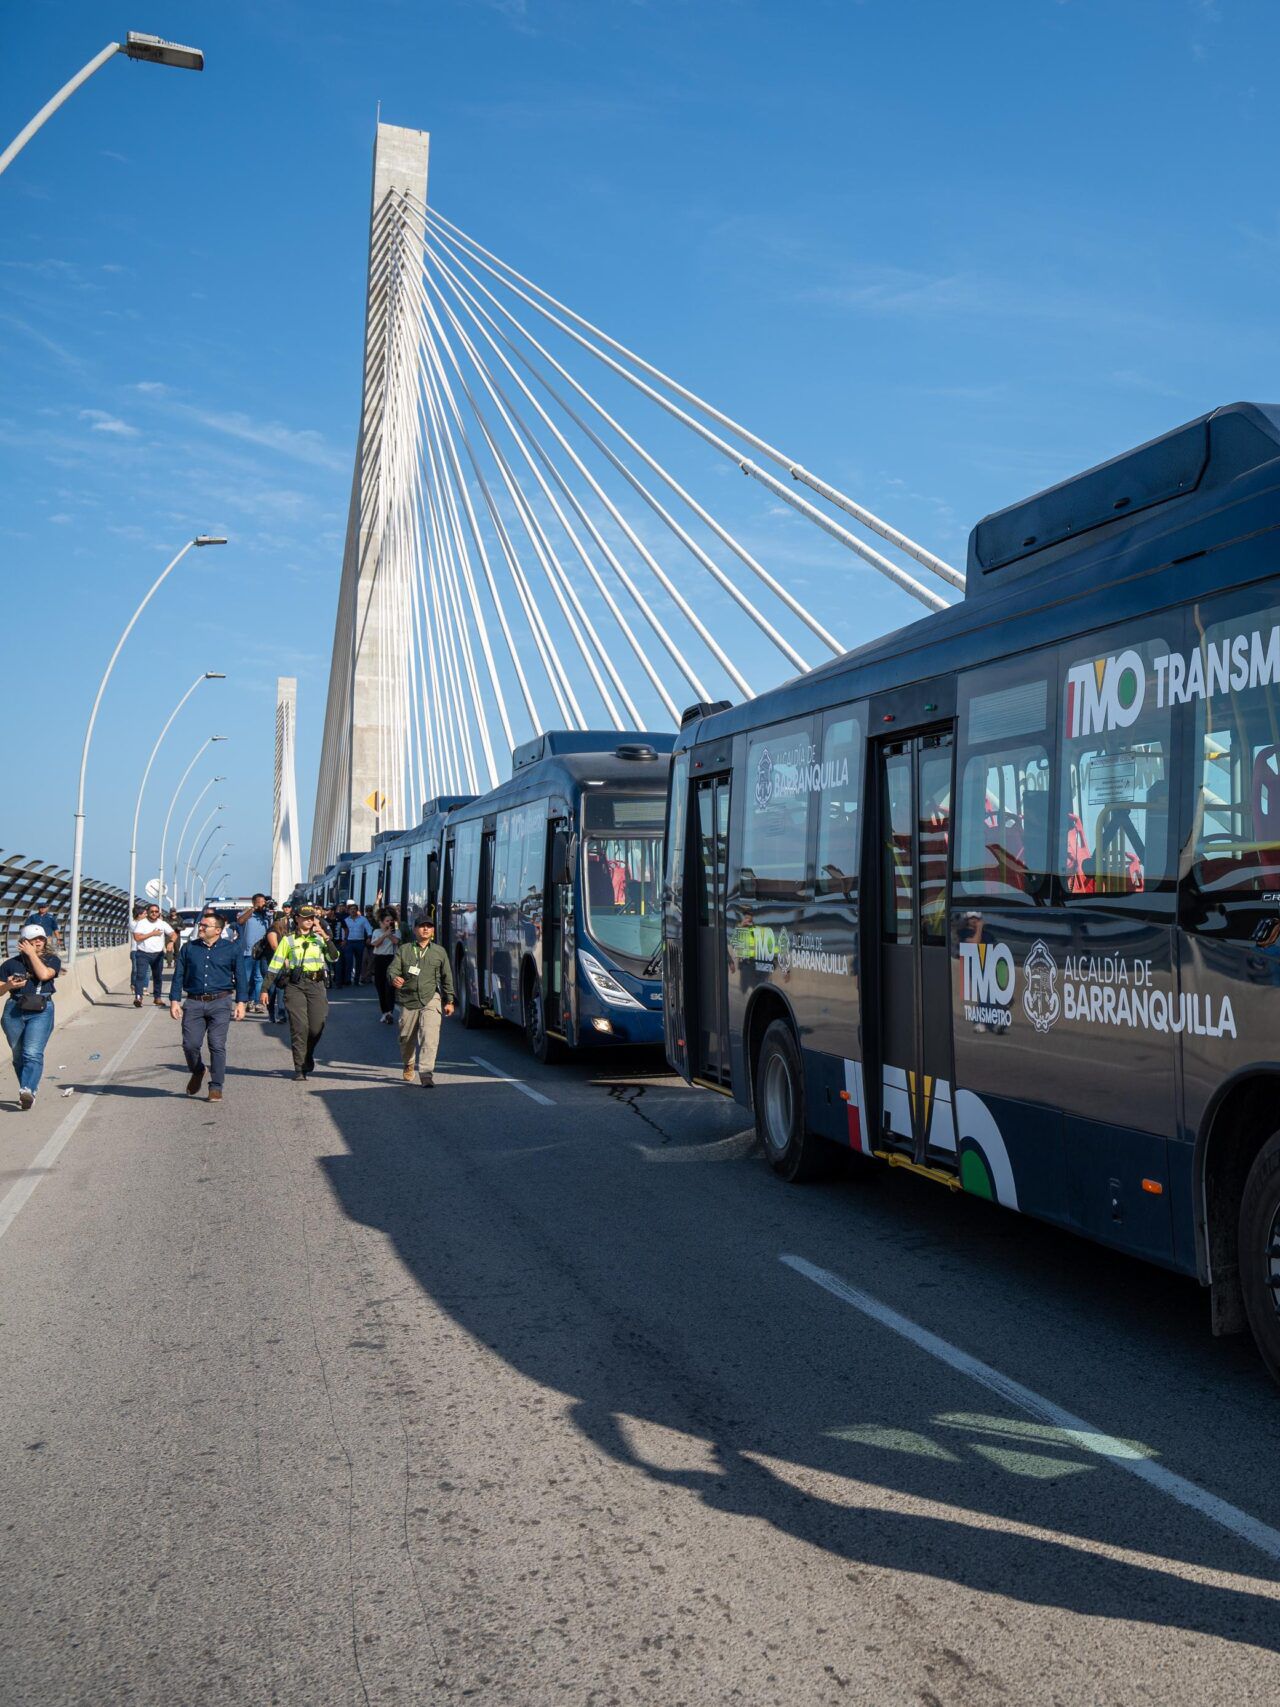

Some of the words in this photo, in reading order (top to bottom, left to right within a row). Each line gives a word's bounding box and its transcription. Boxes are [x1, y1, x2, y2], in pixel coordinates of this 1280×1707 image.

[1066, 650, 1146, 738] TMO
[774, 758, 849, 797] BARRANQUILLA
[792, 949, 849, 976] BARRANQUILLA
[959, 942, 1016, 1005] TMO
[1064, 951, 1129, 985] ALCALDÍA
[1134, 959, 1153, 987] DE
[1064, 983, 1238, 1039] BARRANQUILLA
